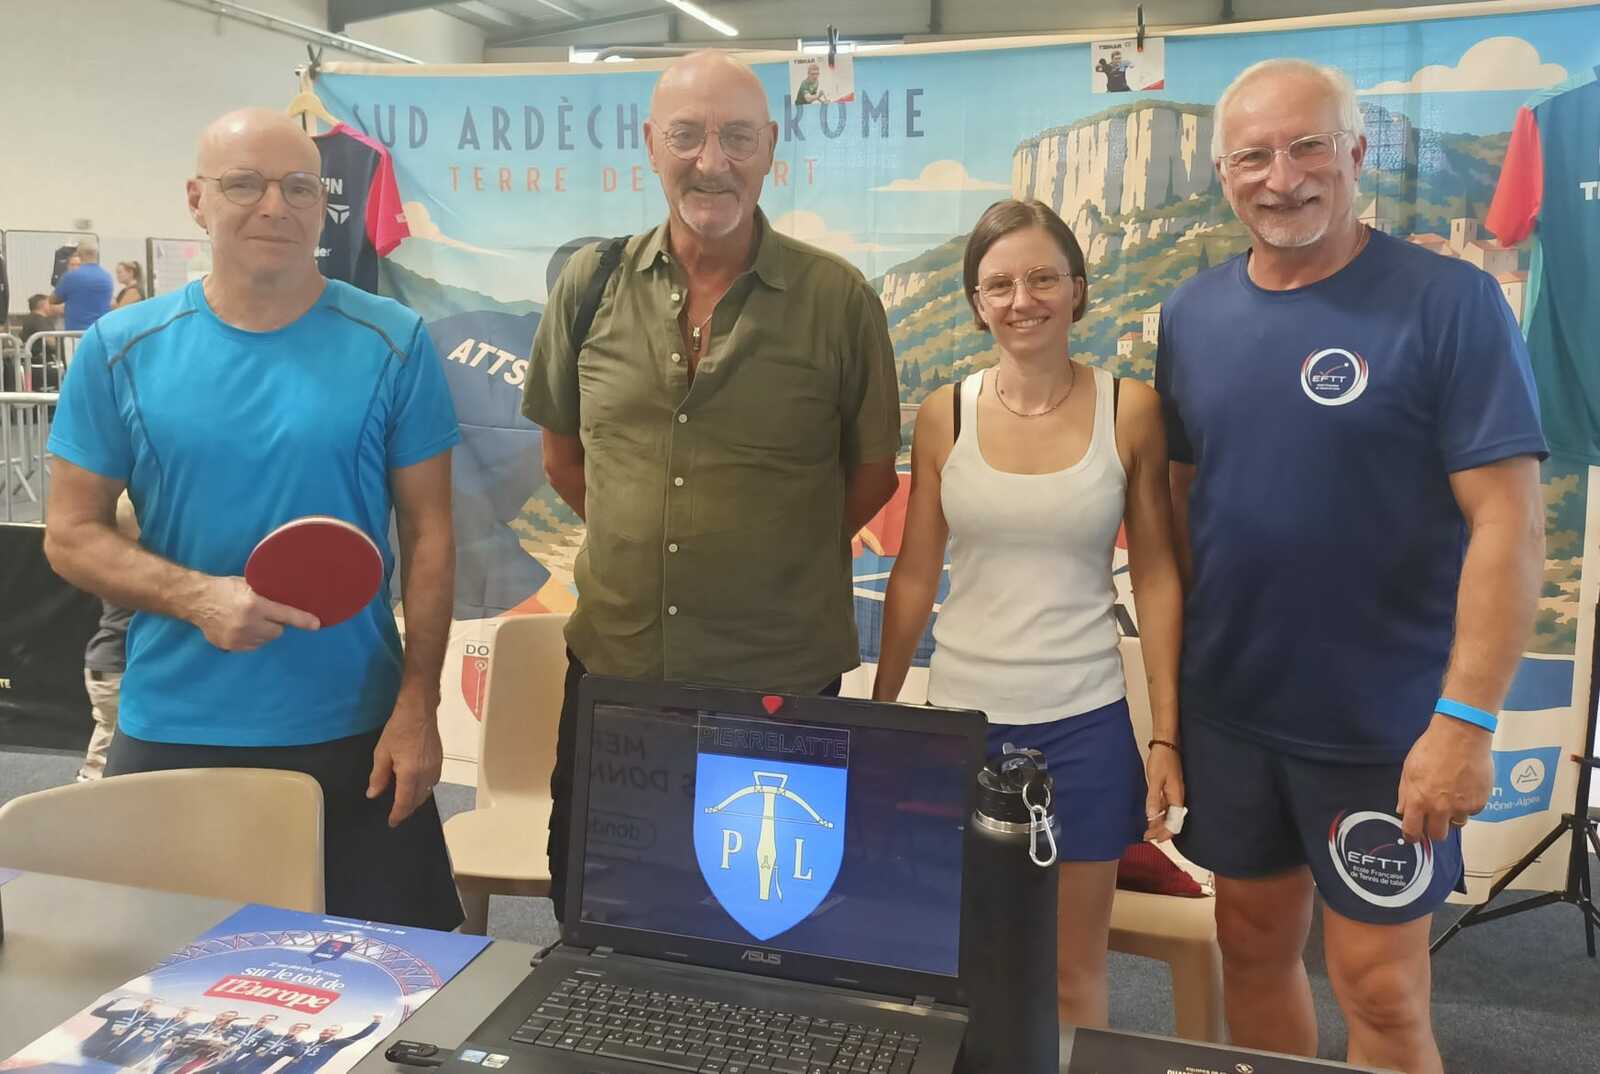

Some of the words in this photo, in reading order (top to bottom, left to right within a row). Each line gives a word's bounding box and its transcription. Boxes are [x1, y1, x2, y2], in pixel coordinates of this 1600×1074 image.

[457, 96, 640, 151] ARDÈCH
[783, 88, 925, 142] ROME
[450, 166, 568, 193] TERRE
[603, 166, 645, 193] DE
[446, 338, 530, 391] ATTS
[1312, 374, 1347, 384] EFTT
[701, 726, 848, 760] PIERRELATTE
[720, 828, 743, 870] P
[792, 838, 813, 881] L
[1347, 850, 1408, 872] EFTT
[740, 950, 782, 966] ASUS
[241, 967, 273, 977] sur
[273, 968, 293, 980] le
[291, 972, 323, 987] toit
[322, 978, 345, 991] de
